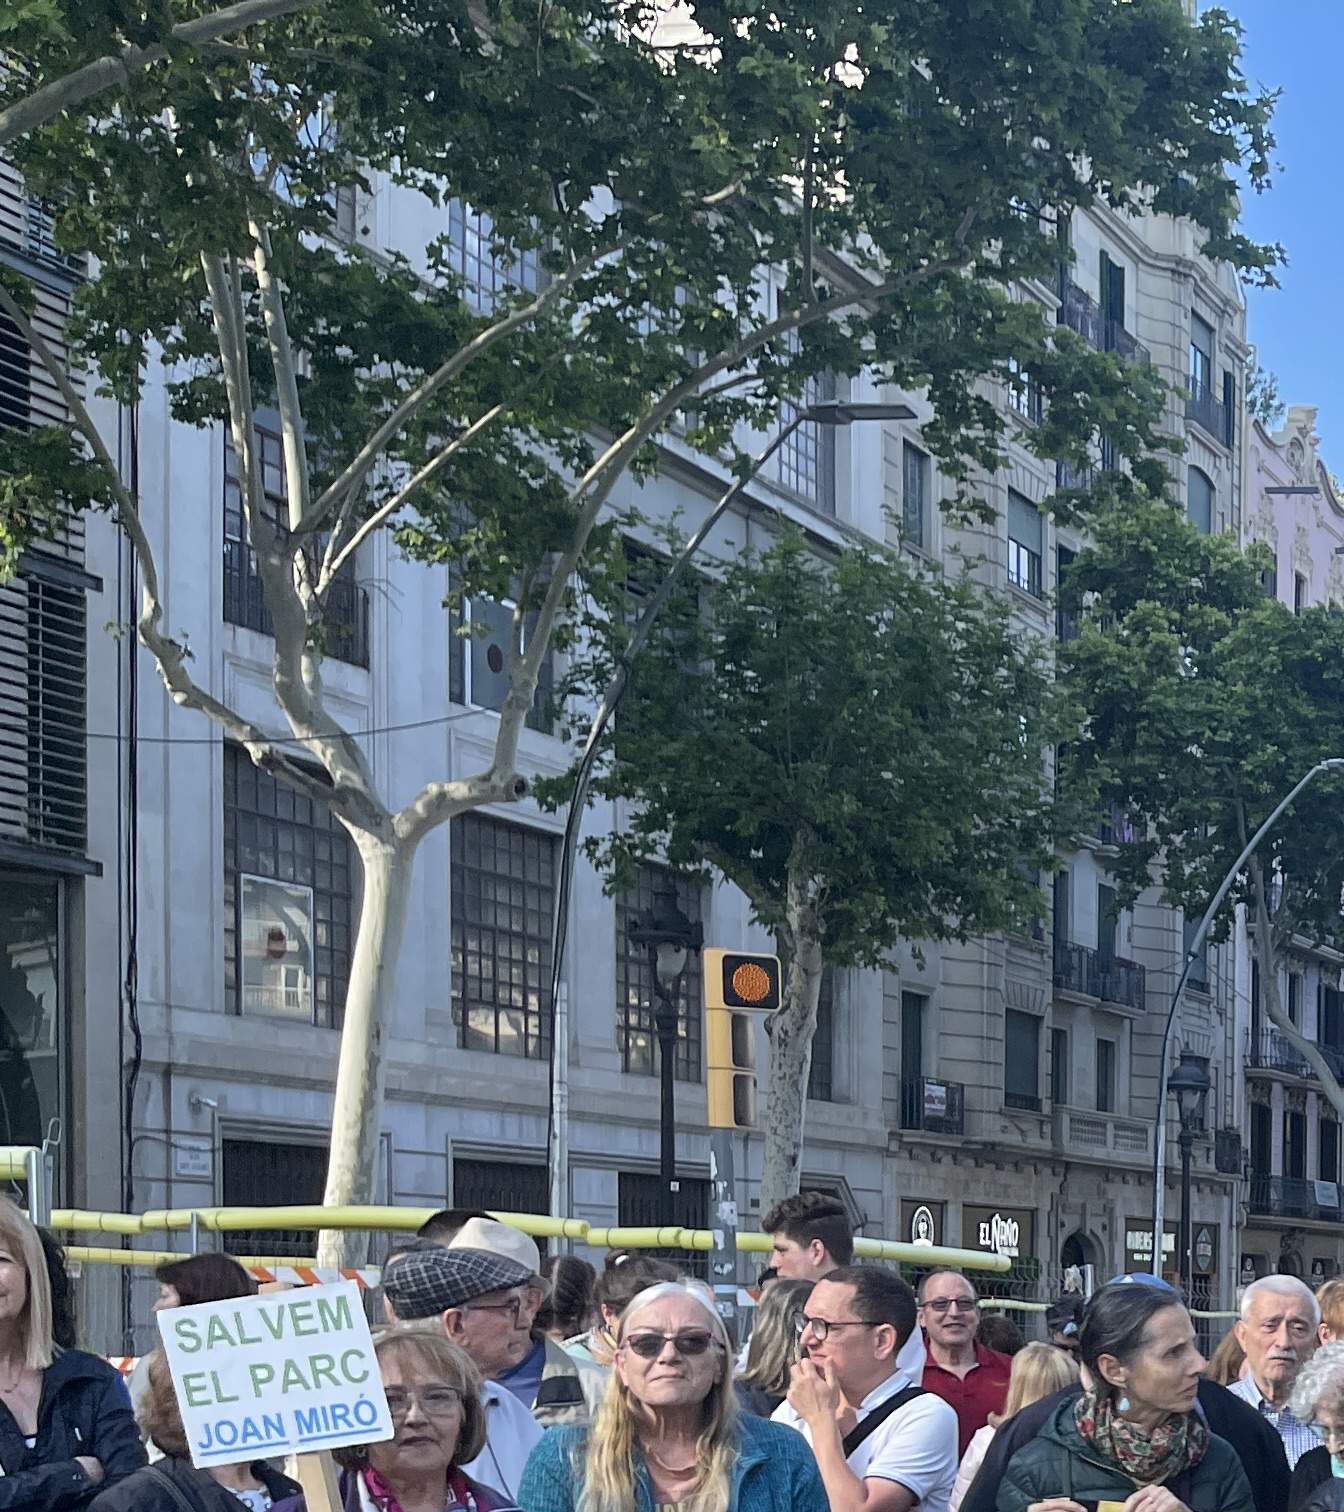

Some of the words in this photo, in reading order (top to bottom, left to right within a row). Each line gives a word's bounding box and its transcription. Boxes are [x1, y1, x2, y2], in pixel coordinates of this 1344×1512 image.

[980, 1222, 991, 1246] EL
[174, 1295, 354, 1353] SALVEM
[182, 1371, 239, 1408] EL
[248, 1349, 370, 1399] PARC
[197, 1413, 286, 1449] JOAN
[293, 1394, 378, 1436] MIRÓ
